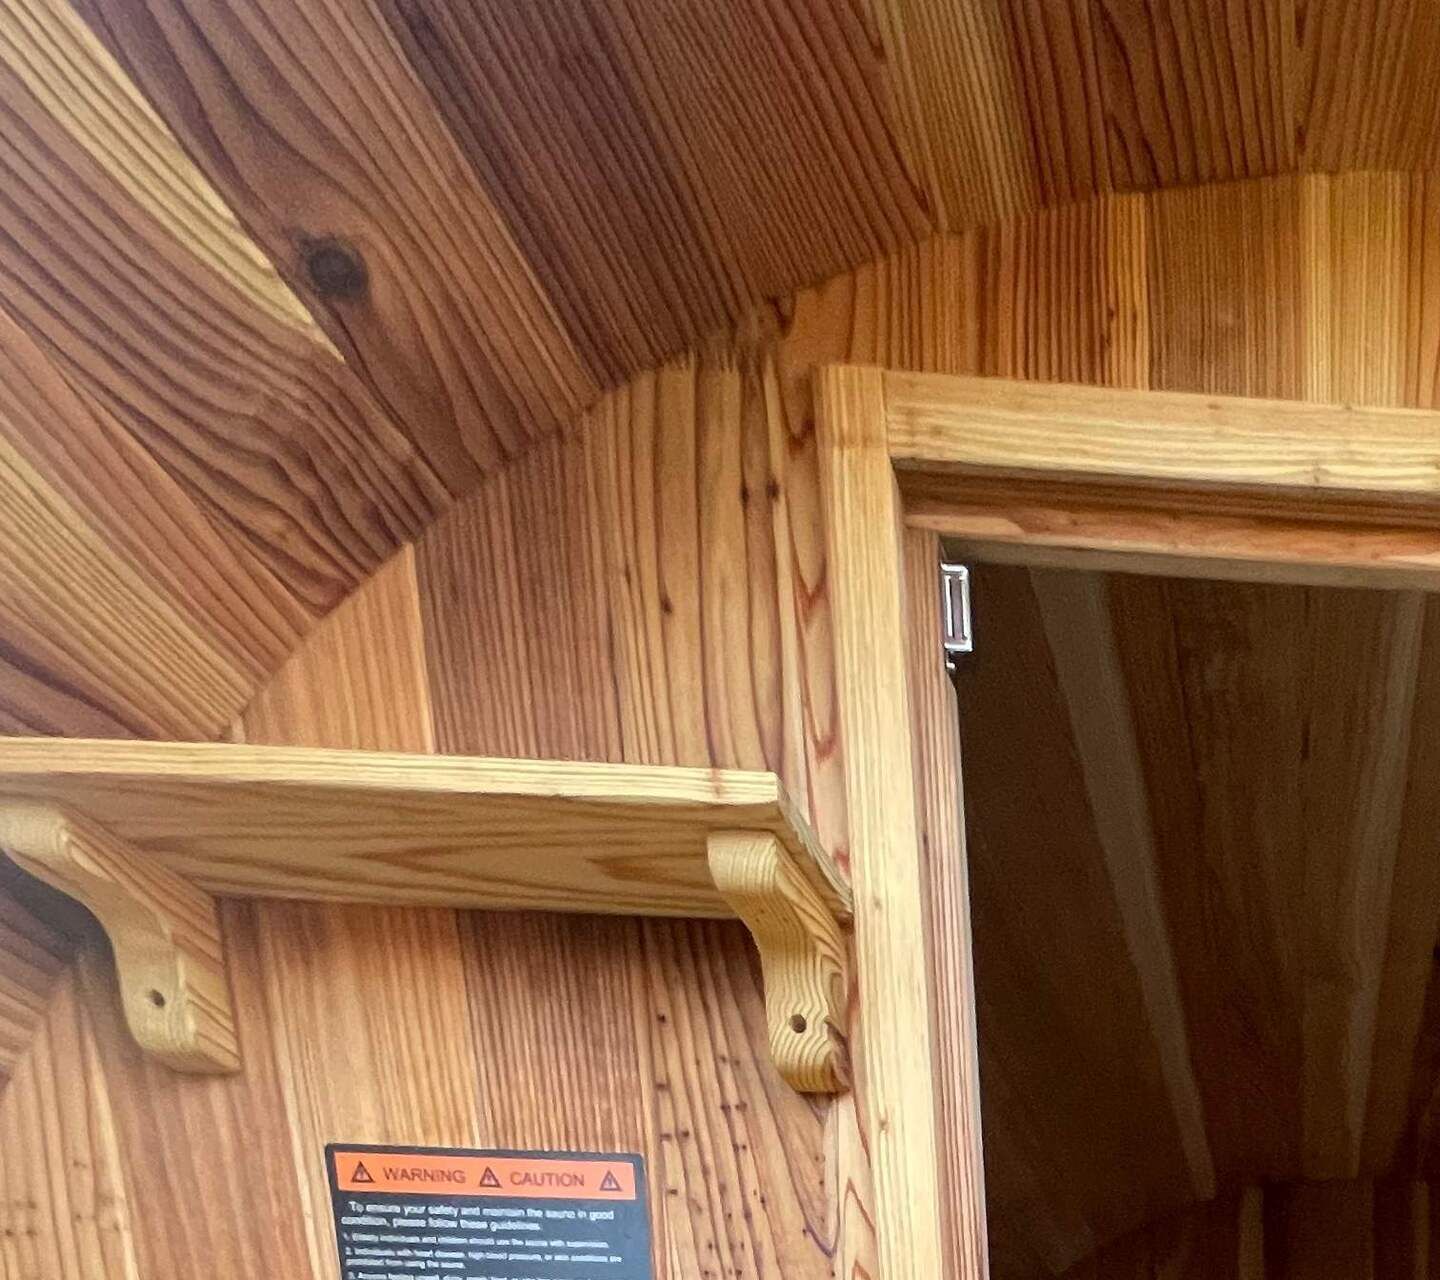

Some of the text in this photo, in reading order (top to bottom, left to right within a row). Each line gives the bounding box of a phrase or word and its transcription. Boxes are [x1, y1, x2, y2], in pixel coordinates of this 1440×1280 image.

[382, 1167, 585, 1187] WARNING CAUTION
[348, 1202, 363, 1212] To
[402, 1205, 425, 1215] your
[460, 1206, 480, 1216] and
[526, 1209, 542, 1218] the
[577, 1210, 587, 1219] in
[588, 1211, 614, 1222] good
